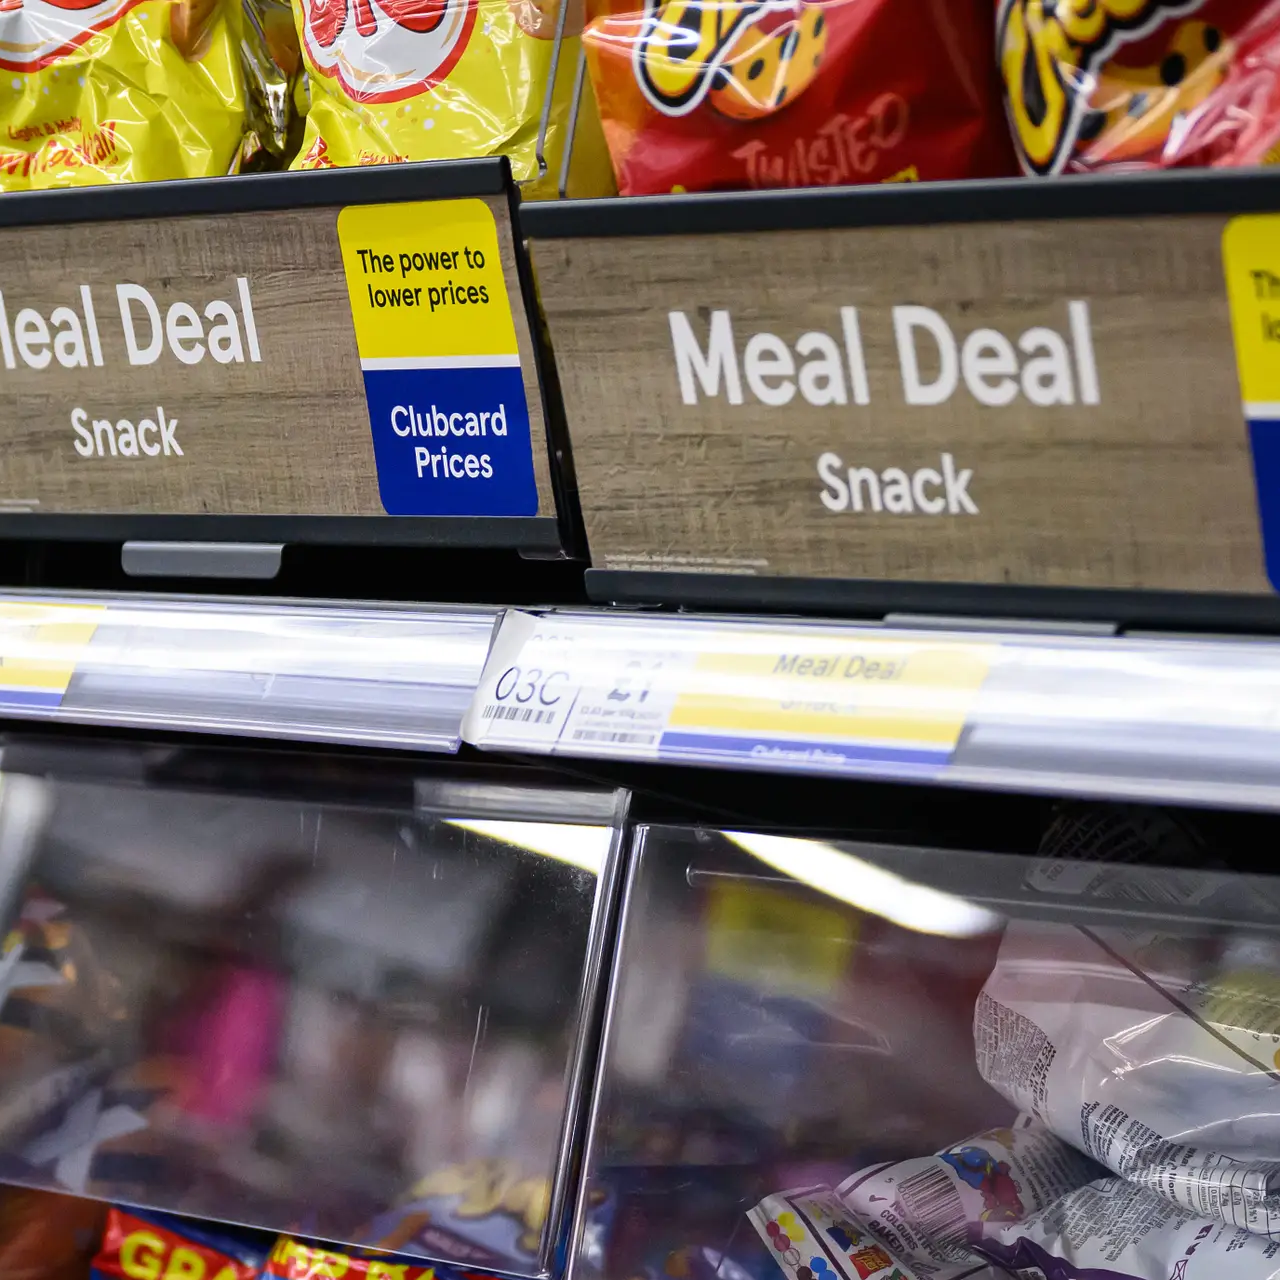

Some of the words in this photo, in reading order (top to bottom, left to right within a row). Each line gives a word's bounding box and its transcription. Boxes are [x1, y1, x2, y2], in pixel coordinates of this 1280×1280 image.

[356, 249, 393, 274] The
[399, 253, 458, 281] power
[464, 247, 486, 270] to
[368, 284, 424, 308] lower
[428, 283, 489, 312] prices
[116, 278, 262, 366] Deal
[668, 307, 871, 406] Meal
[892, 300, 1100, 406] Deal
[71, 407, 184, 457] Snack
[390, 405, 508, 441] Clubcard
[415, 447, 493, 479] Prices
[817, 455, 979, 517] Snack
[495, 665, 569, 706] 03C
[773, 653, 837, 680] Meal
[844, 654, 906, 681] Deal
